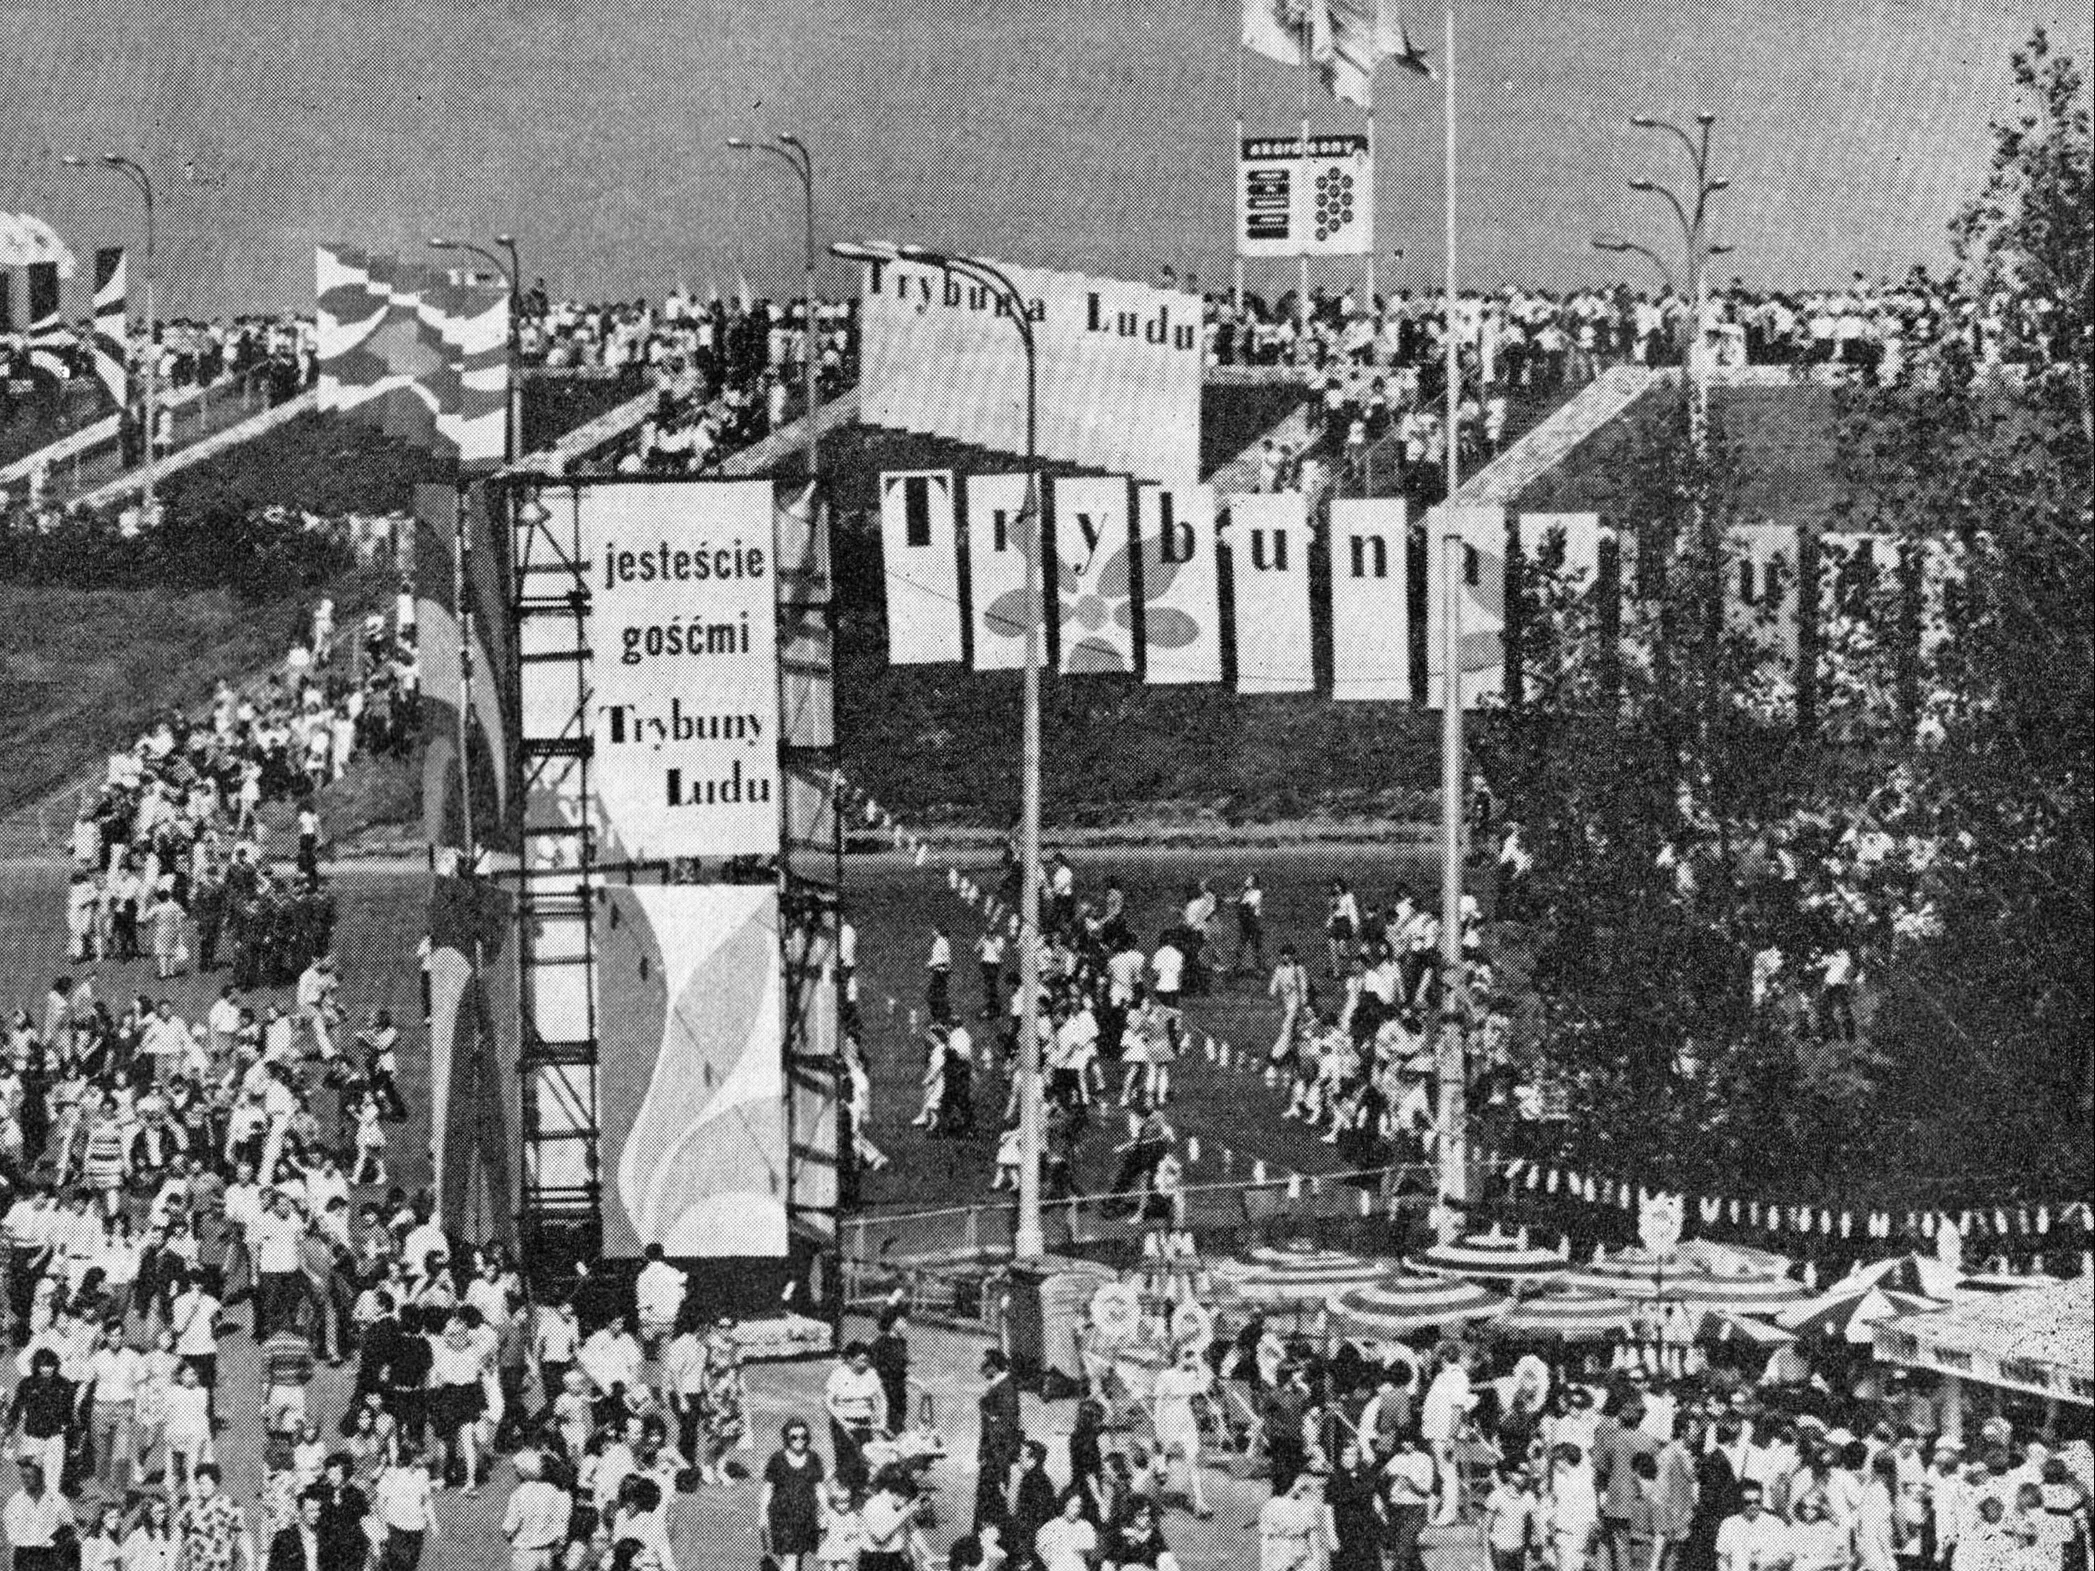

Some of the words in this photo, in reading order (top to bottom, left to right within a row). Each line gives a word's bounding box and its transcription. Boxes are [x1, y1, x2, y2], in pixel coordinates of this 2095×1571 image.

[870, 262, 1046, 321] Trybuna
[1087, 292, 1195, 350] Ludu
[606, 540, 764, 589] jesteście
[622, 611, 750, 664] gośćmi
[599, 698, 762, 750] Trybuny
[667, 760, 769, 806] Ludu
